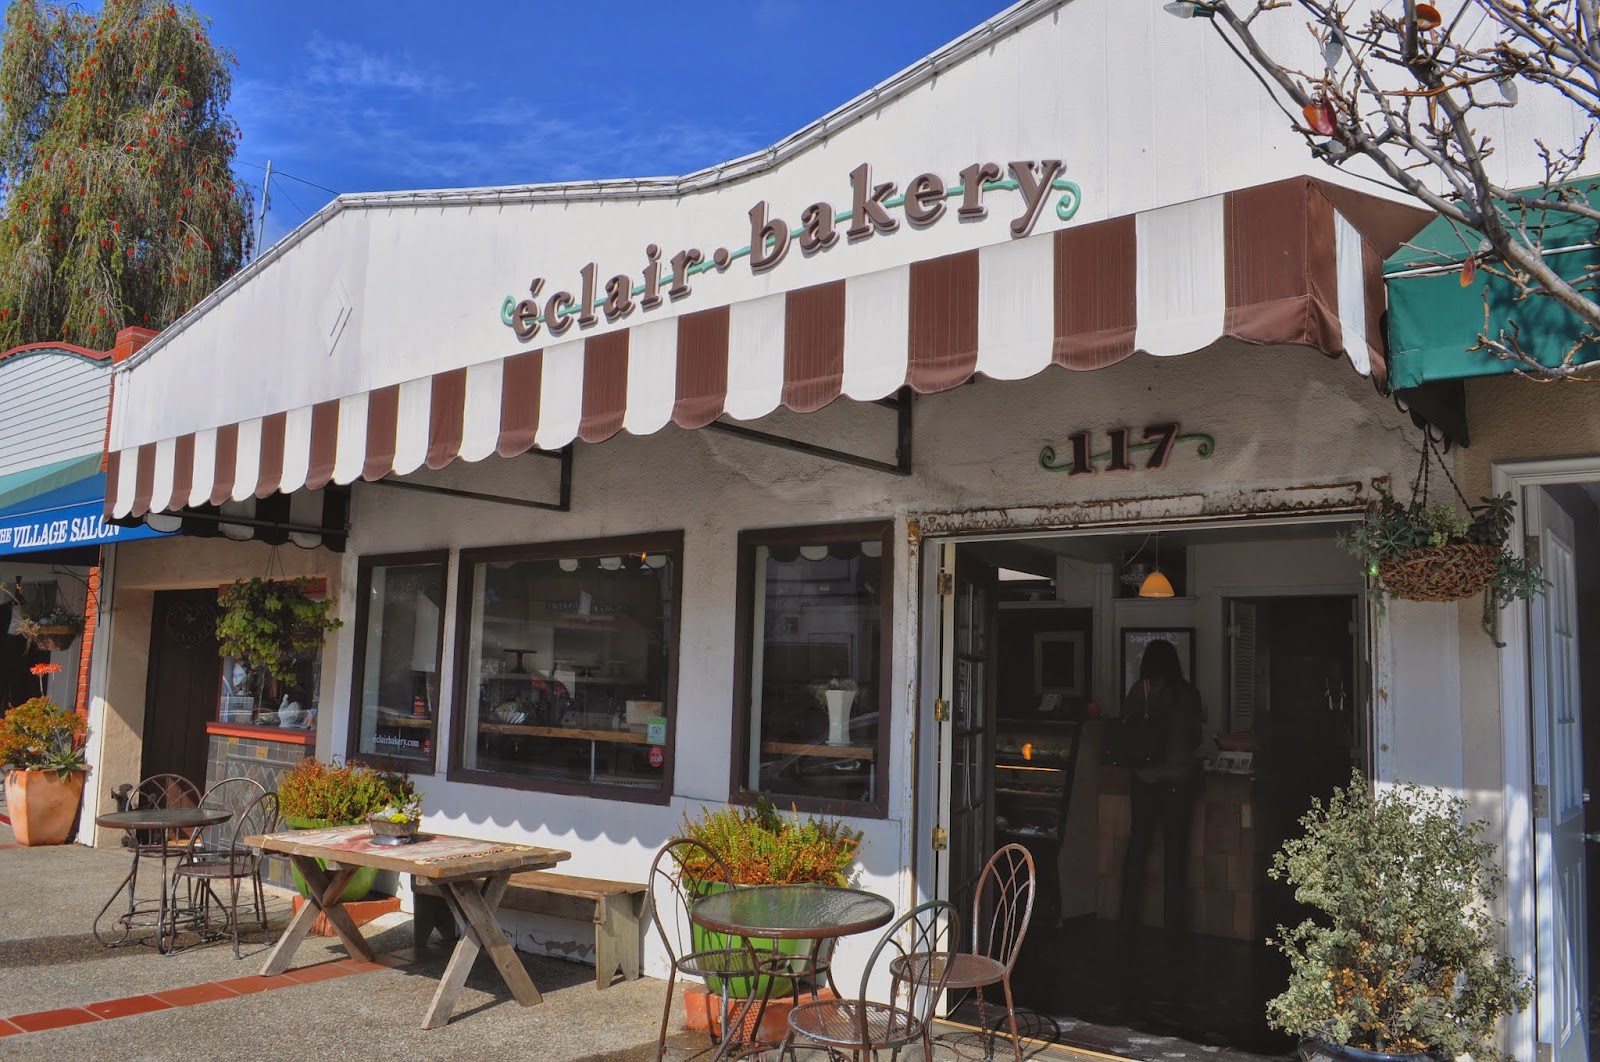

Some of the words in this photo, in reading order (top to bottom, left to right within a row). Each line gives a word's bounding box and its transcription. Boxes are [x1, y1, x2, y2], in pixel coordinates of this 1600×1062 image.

[512, 243, 704, 340] éclair
[749, 159, 1067, 272] bakery
[1068, 423, 1180, 477] 117
[0, 527, 12, 543] HE
[13, 520, 68, 548] VILLAGE
